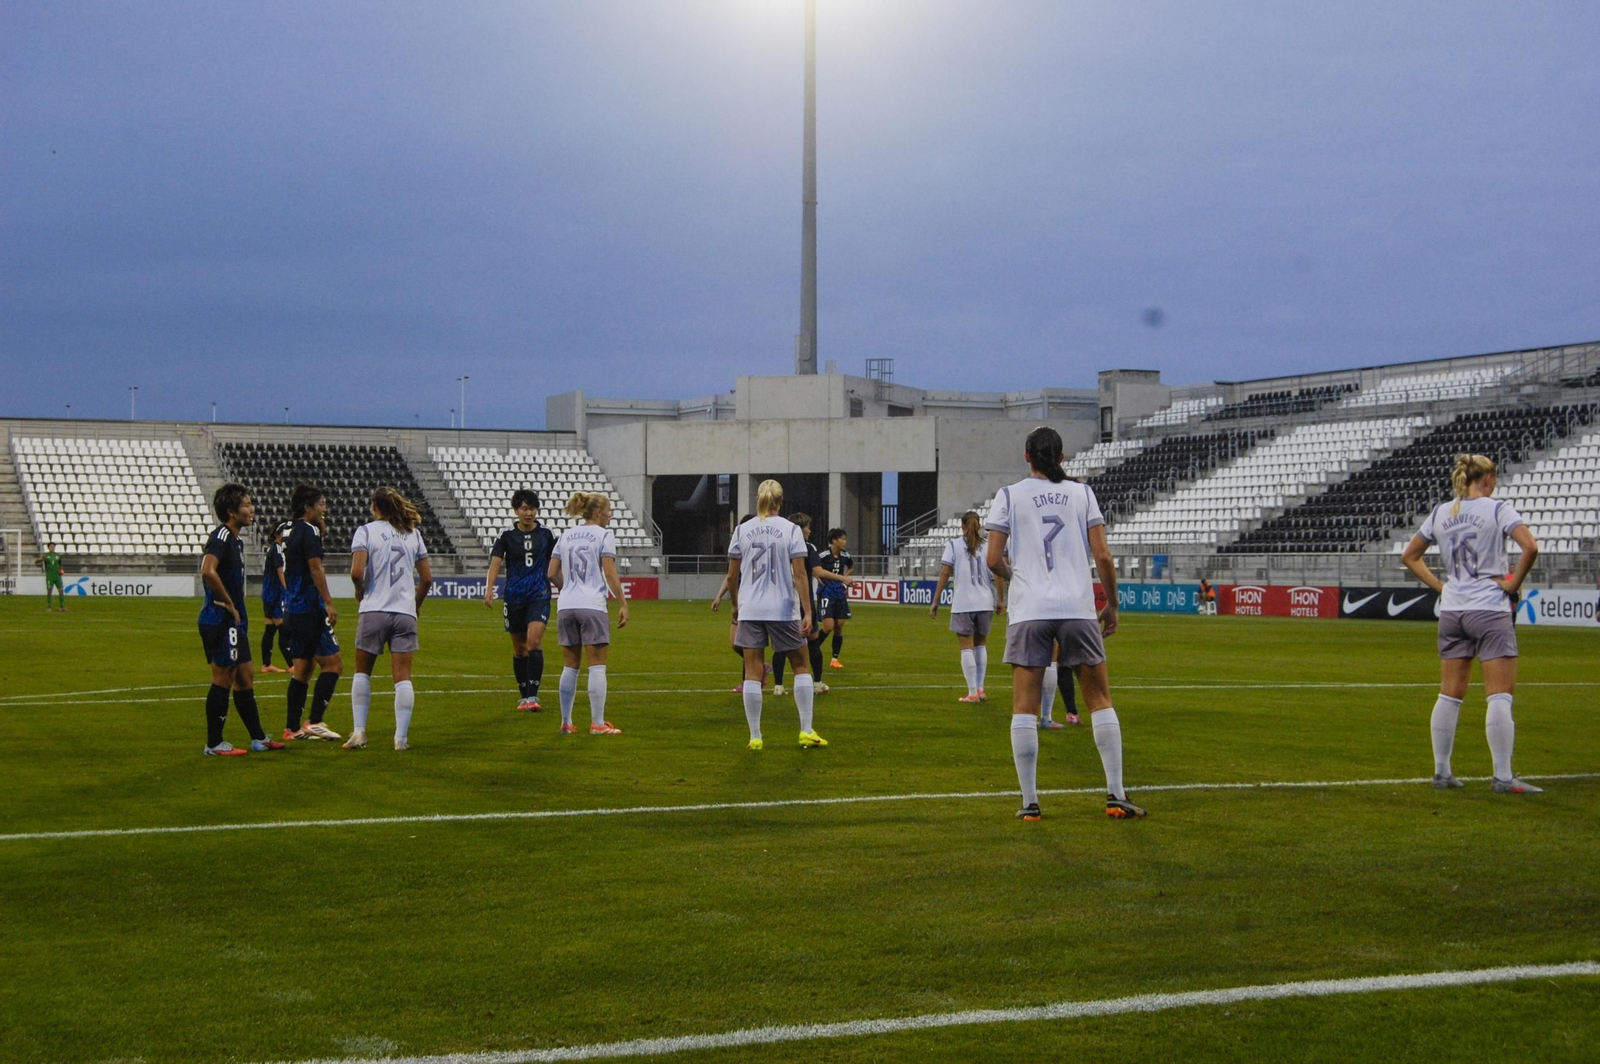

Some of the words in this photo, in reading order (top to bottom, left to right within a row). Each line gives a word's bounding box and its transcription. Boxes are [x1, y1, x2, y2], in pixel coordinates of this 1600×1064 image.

[1032, 492, 1069, 508] ENGEN
[1042, 515, 1065, 573] 7
[525, 552, 533, 567] 6
[567, 545, 589, 584] 15
[751, 542, 777, 586] 21
[1449, 532, 1478, 582] 16
[389, 546, 406, 588] 2
[91, 579, 153, 597] telenor
[865, 583, 898, 600] VG
[903, 582, 931, 604] bama
[1232, 585, 1267, 605] THON
[1287, 586, 1323, 605] THON
[821, 597, 829, 608] 17
[1117, 586, 1136, 609] DNB
[1141, 587, 1160, 609] DNB
[1166, 587, 1186, 610] DNB
[1235, 605, 1262, 616] HOTELS
[1290, 607, 1318, 617] HOTELS
[228, 627, 238, 646] 8
